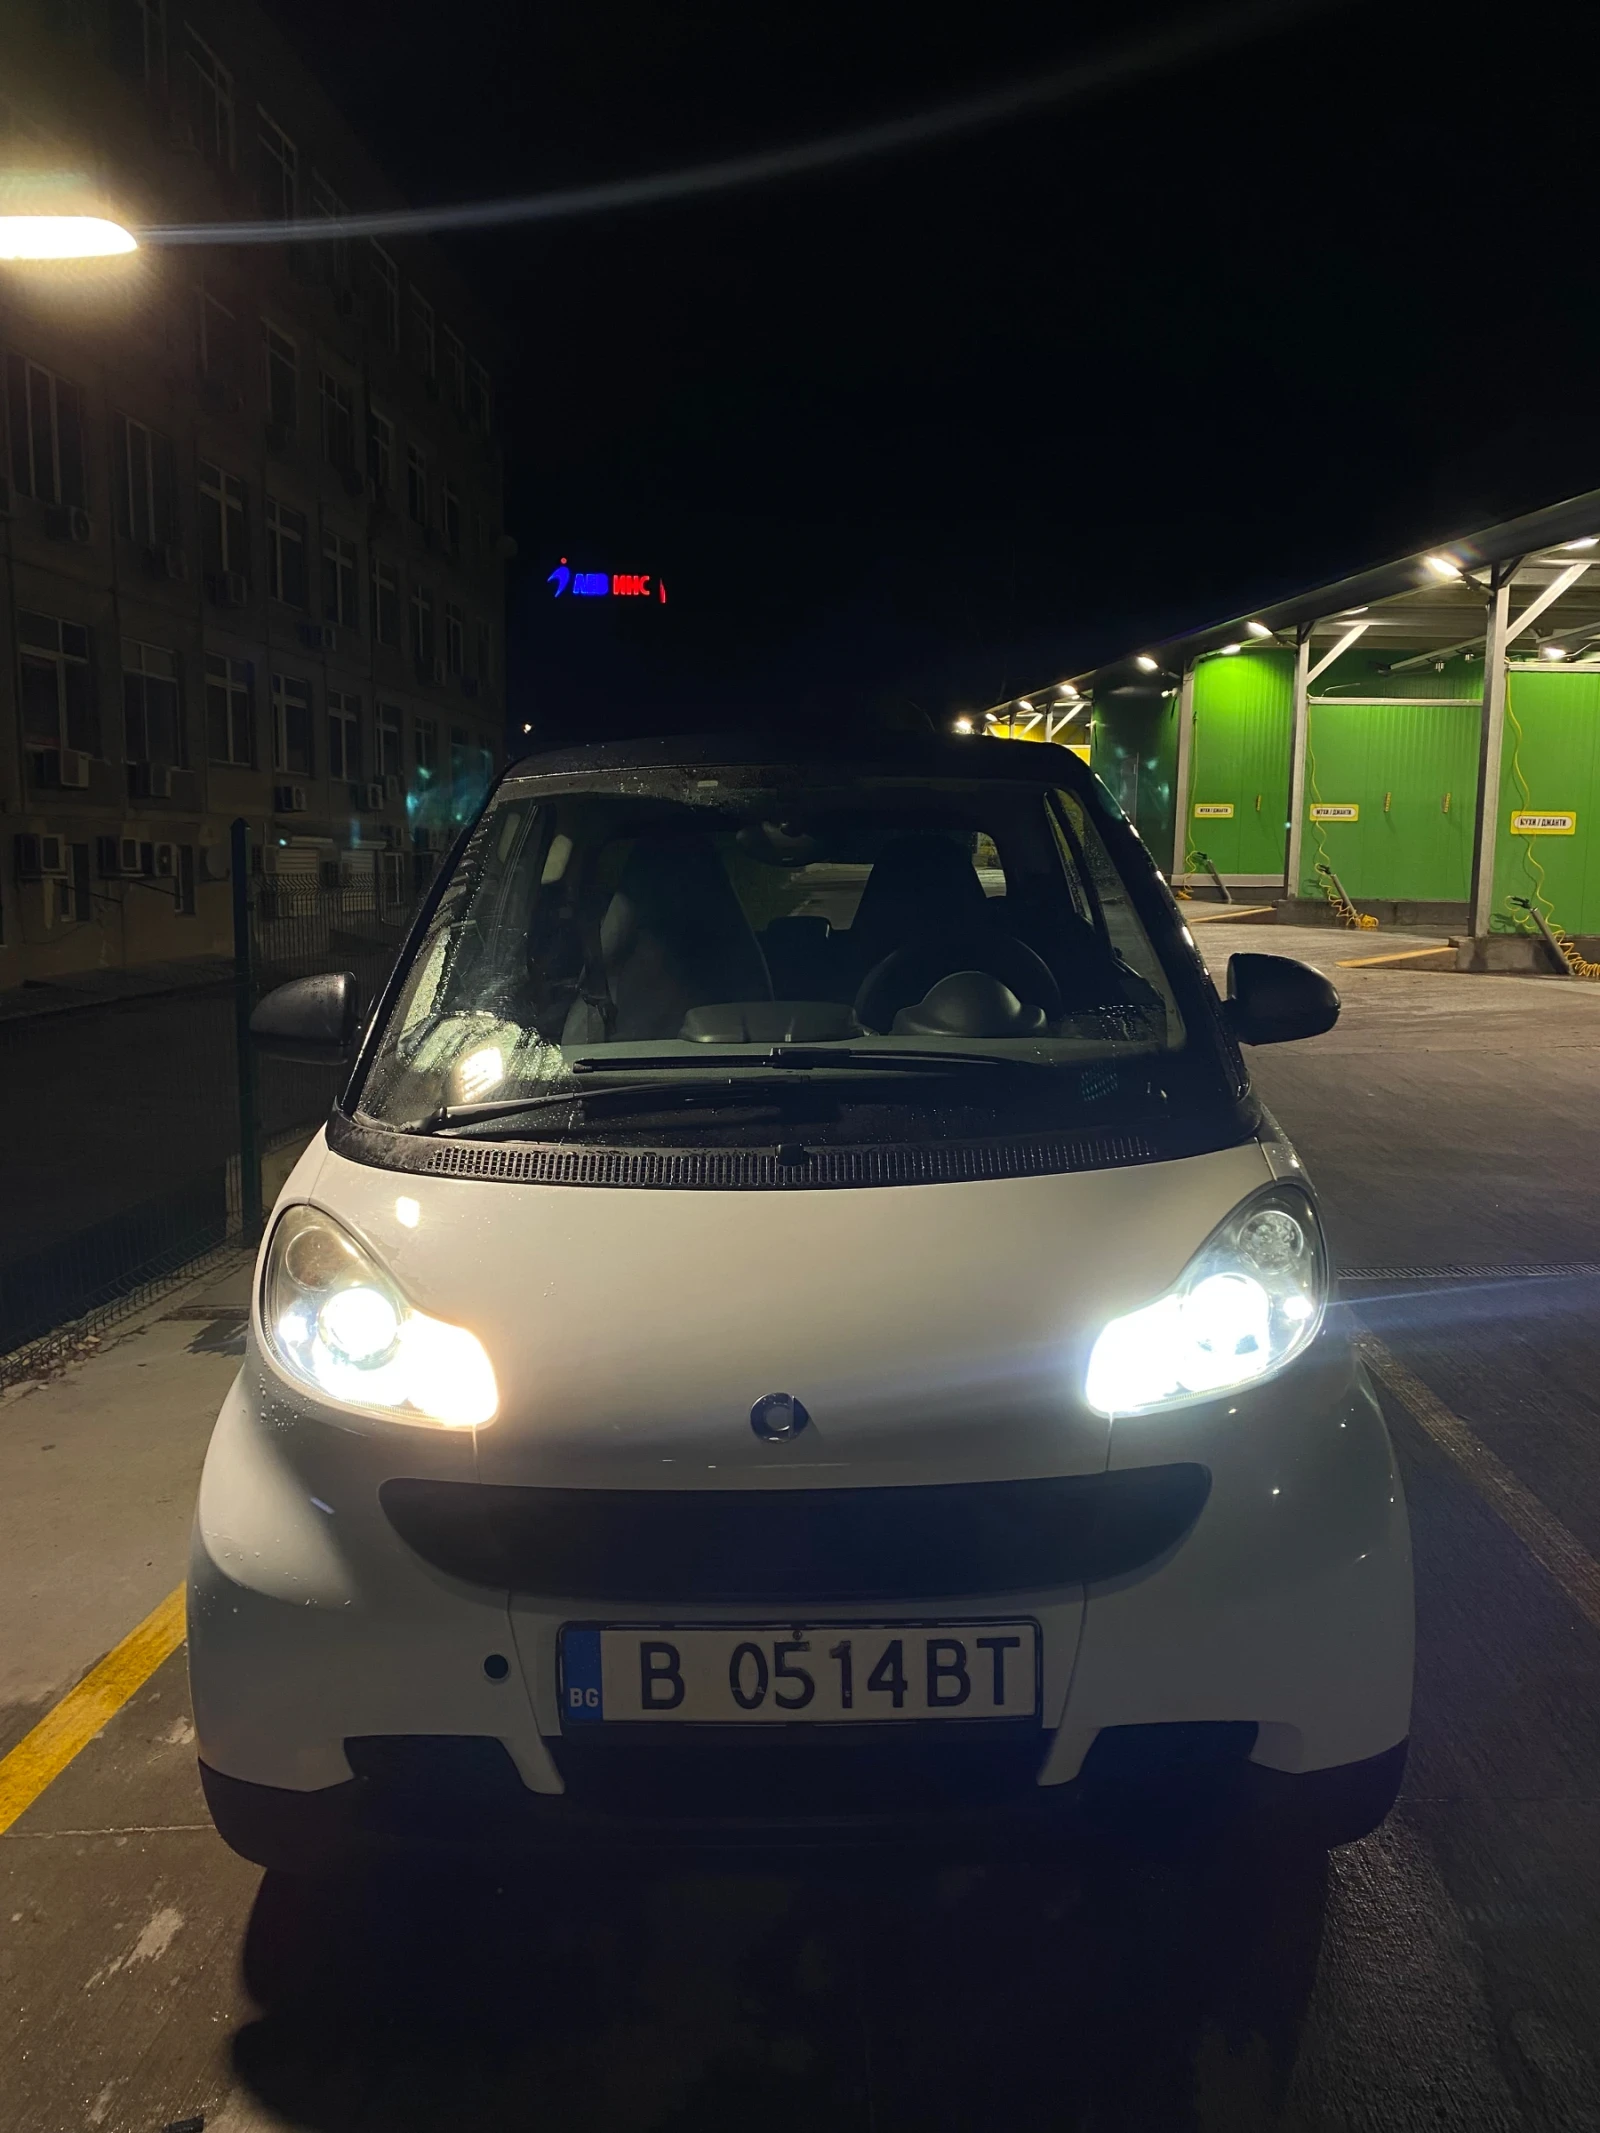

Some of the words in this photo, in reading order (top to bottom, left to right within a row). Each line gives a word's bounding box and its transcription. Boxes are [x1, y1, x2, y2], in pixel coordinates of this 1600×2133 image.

[613, 574, 650, 596] ИНС
[1541, 818, 1567, 827] ДЖАНТИ
[640, 1641, 685, 1710] B
[569, 1687, 599, 1708] BG
